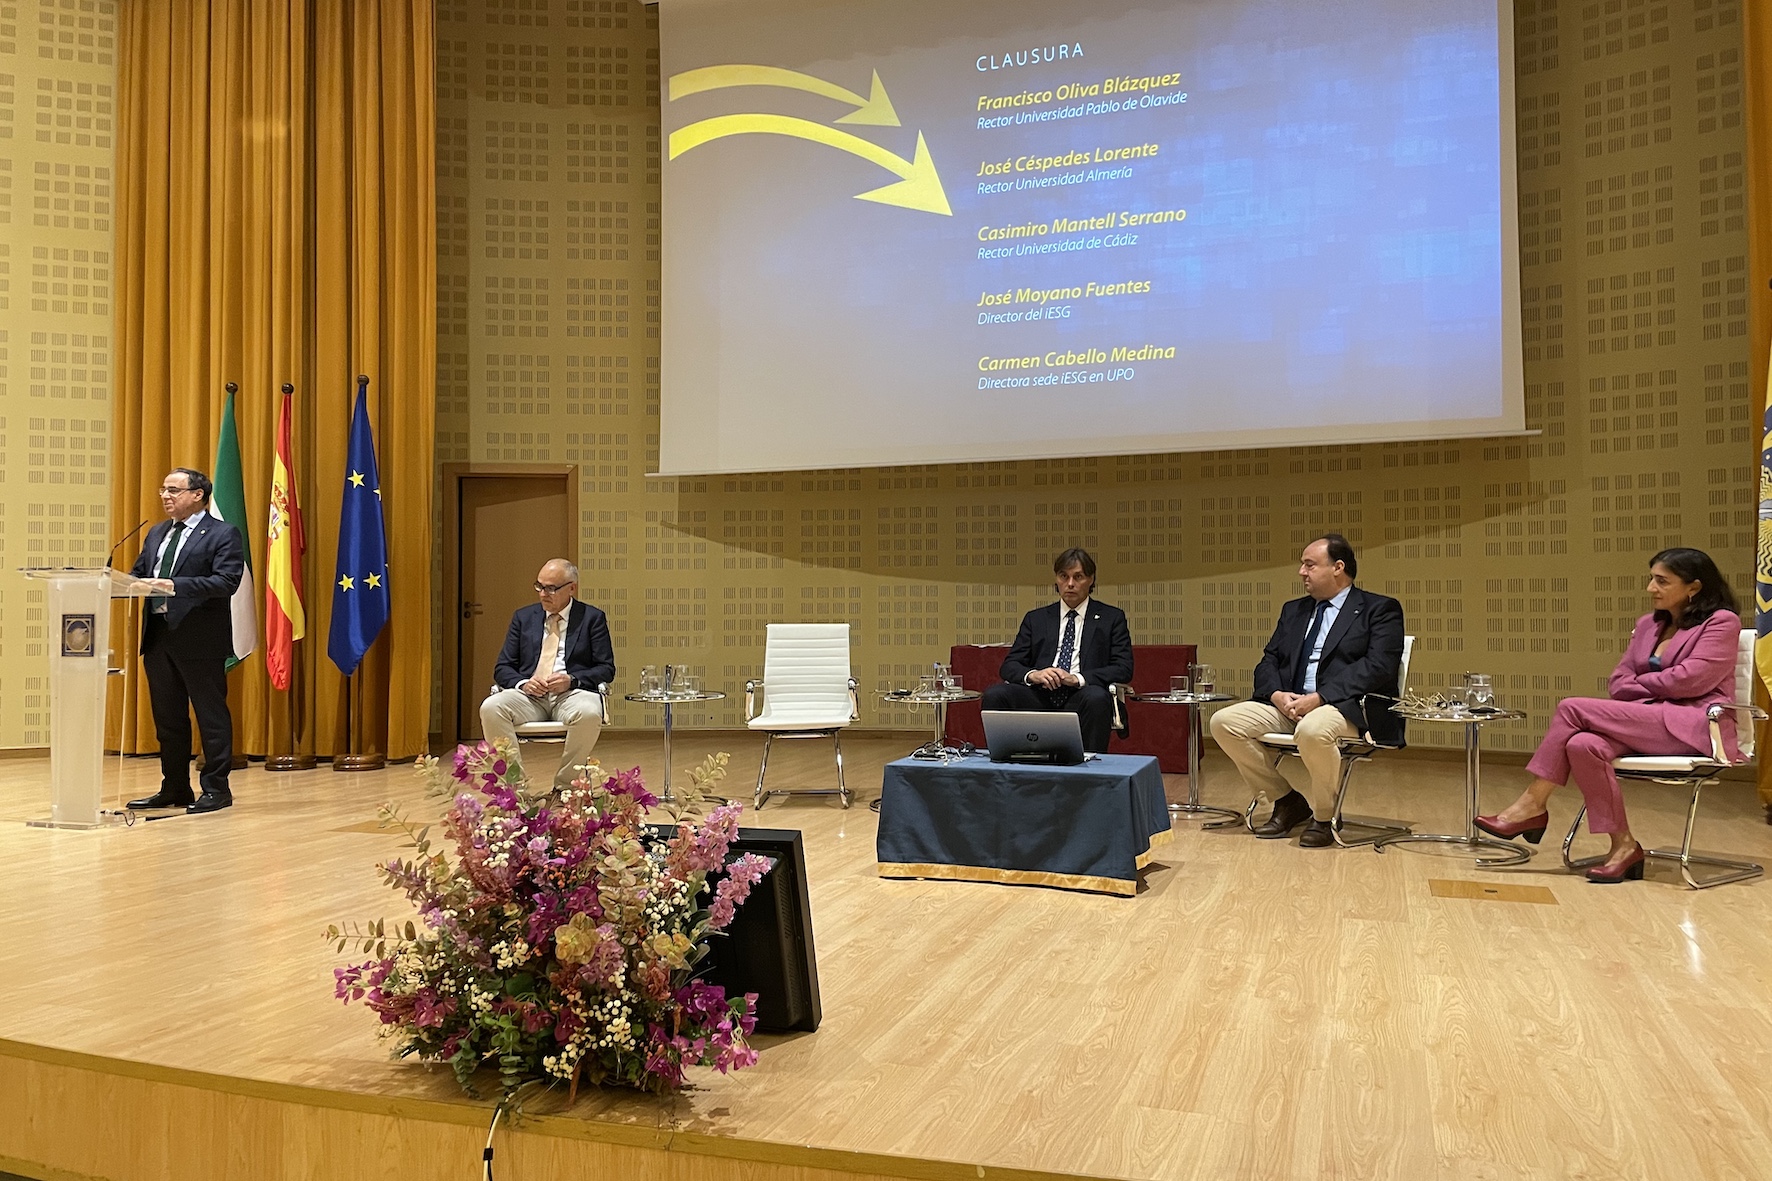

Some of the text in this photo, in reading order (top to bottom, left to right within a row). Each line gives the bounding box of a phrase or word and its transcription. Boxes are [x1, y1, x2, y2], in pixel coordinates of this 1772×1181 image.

[976, 43, 1084, 71] CLAUSURA
[977, 72, 1181, 111] Francisco Oliva Blázquez
[977, 91, 1187, 129] Rector Universidad Pablo de Olavide
[977, 143, 1158, 176] José Céspedes Lorente
[977, 166, 1132, 194] Rector Universidad Almería
[978, 209, 1186, 241] Casimiro Mantell Serrano
[978, 233, 1138, 259] Rector Universidad de Cádiz
[977, 280, 1151, 306] José Moyano Fuentes
[978, 306, 1071, 324] Director del iESG
[978, 345, 1175, 371] Carmen Cabello Medina
[978, 368, 1134, 389] Directora sede iESG en UPO
